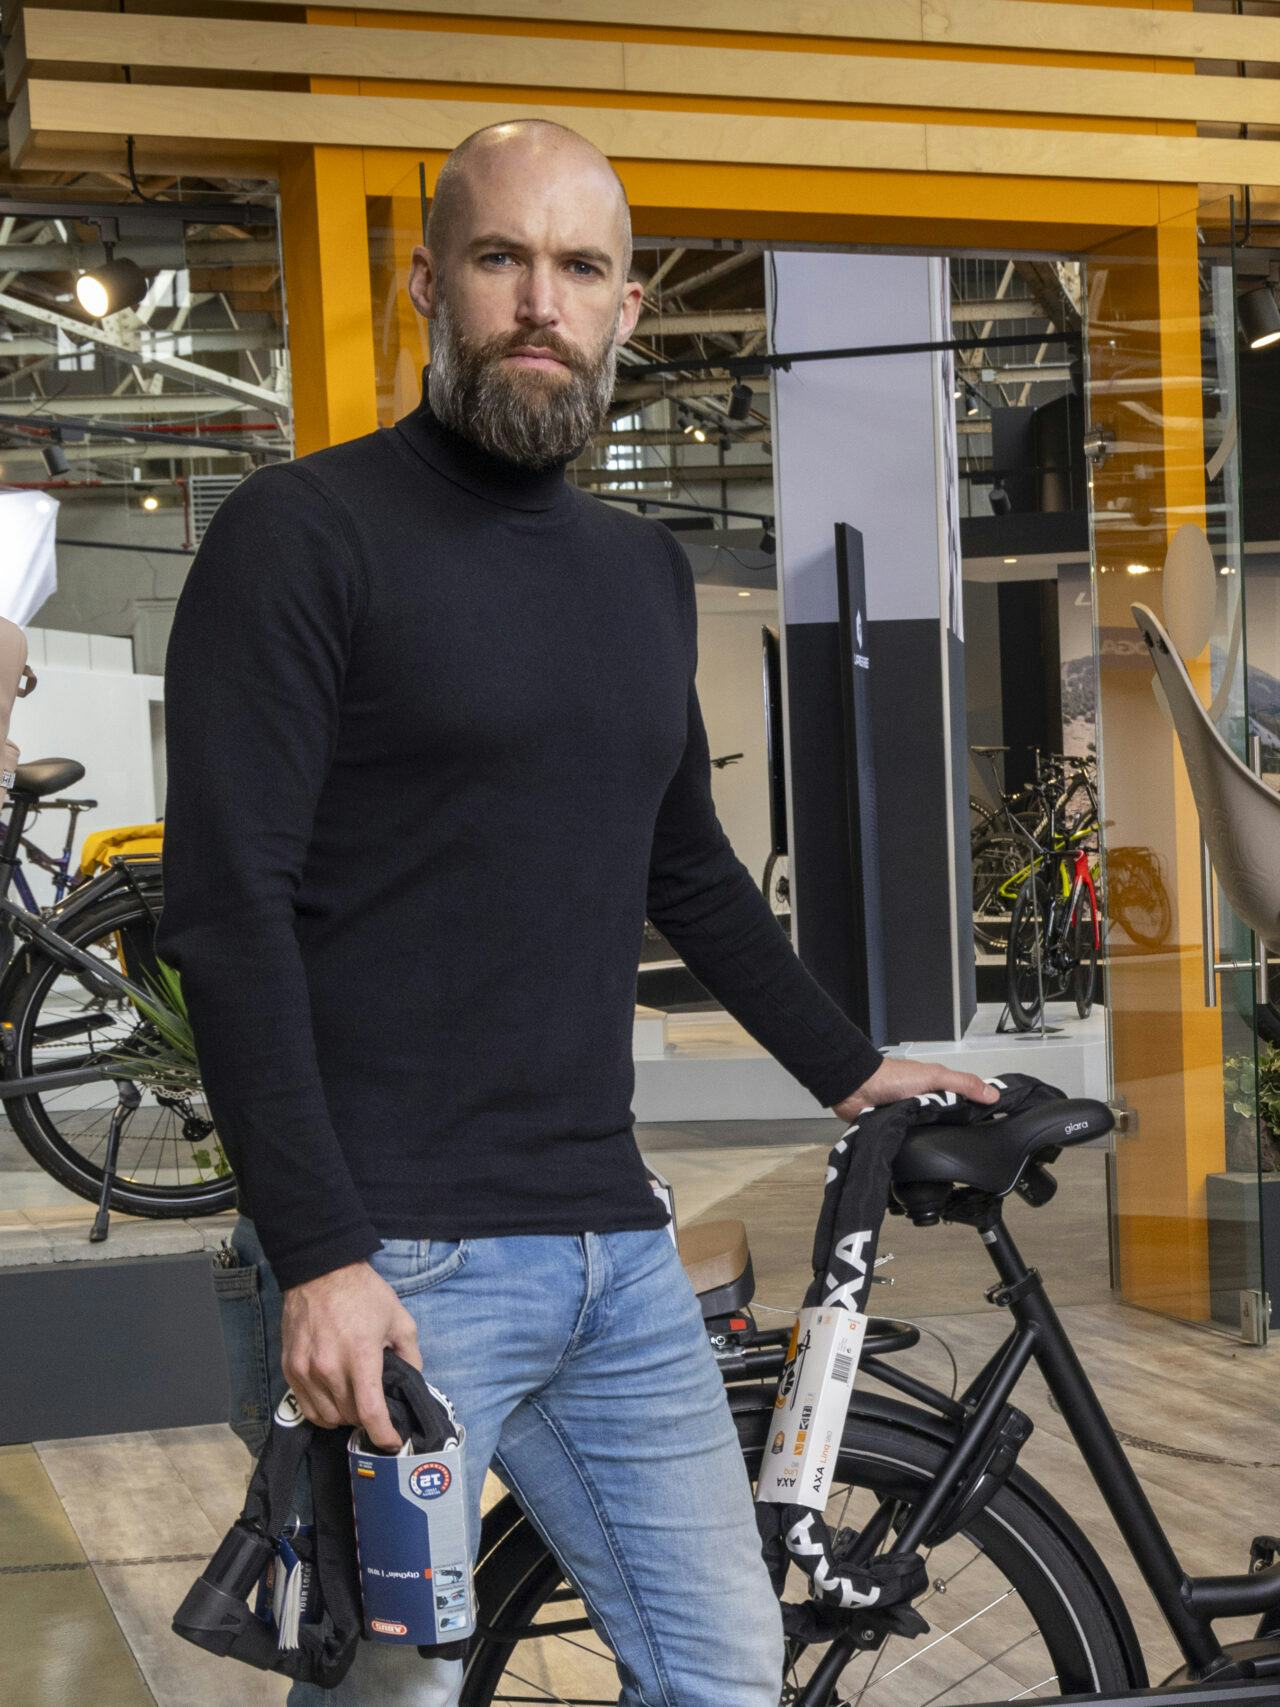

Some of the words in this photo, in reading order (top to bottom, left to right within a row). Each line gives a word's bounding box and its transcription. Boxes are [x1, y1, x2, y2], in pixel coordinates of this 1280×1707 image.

[1065, 1120, 1089, 1135] giara
[420, 1473, 442, 1488] 12
[776, 1477, 797, 1488] AXA
[813, 1467, 825, 1494] AXA
